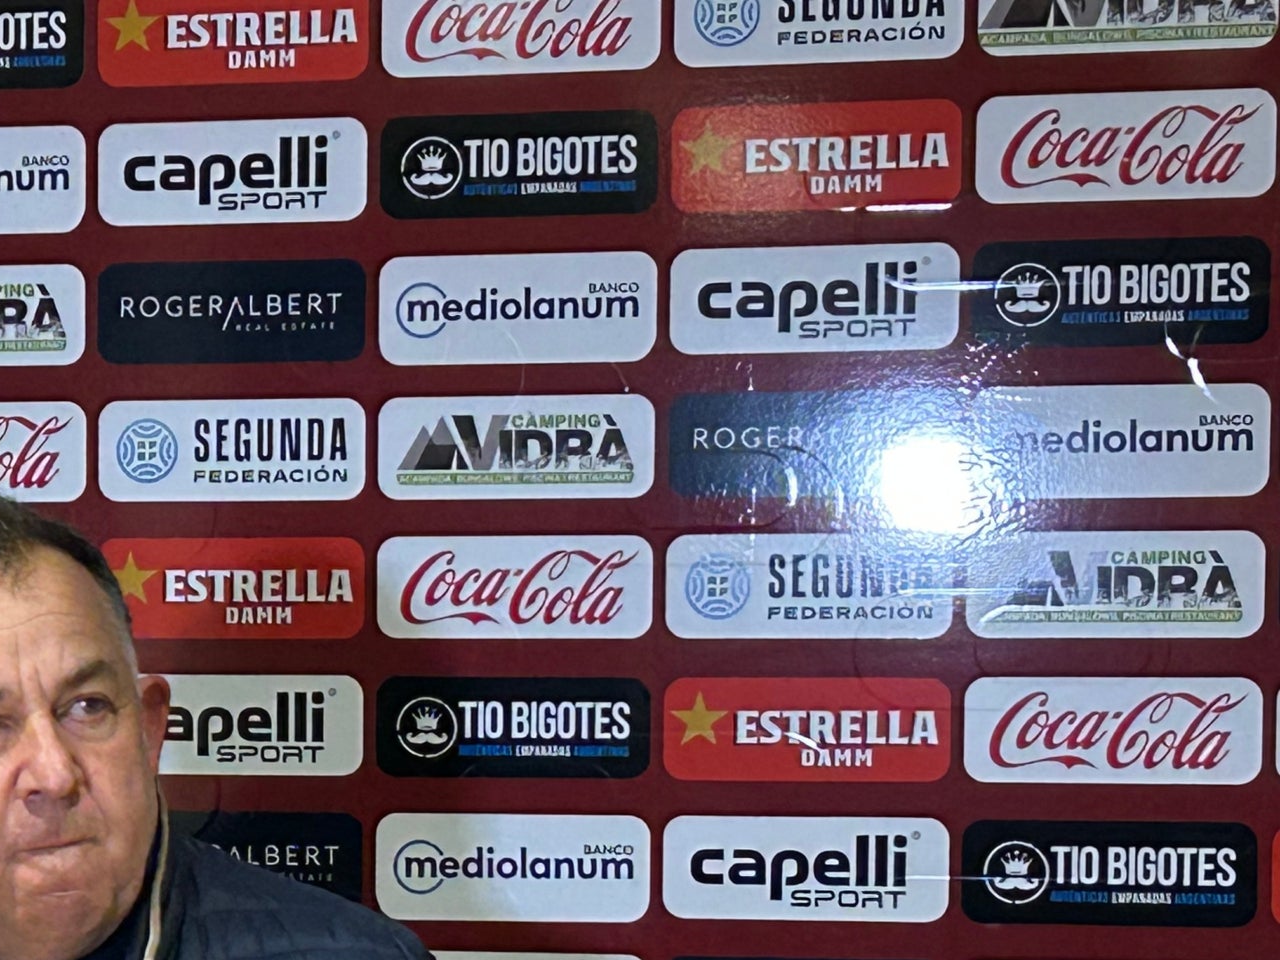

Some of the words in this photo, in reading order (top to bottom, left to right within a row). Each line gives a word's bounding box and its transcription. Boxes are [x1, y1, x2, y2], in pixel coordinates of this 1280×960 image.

[166, 10, 357, 50] ESTRELLA
[777, 23, 945, 45] FEDERACIÓN
[228, 49, 295, 69] DAMM
[22, 155, 69, 166] BANCO
[464, 139, 509, 177] TIO
[517, 135, 637, 176] BIGOTES
[745, 132, 949, 173] ESTRELLA
[124, 135, 328, 205] capelli
[810, 173, 882, 195] DAMM
[218, 191, 327, 211] SPORT
[589, 282, 639, 295] BANCO
[698, 261, 917, 333] capelli
[1062, 265, 1112, 305] TIO
[1120, 262, 1250, 304] BIGOTES
[407, 287, 639, 321] mediolanum
[798, 319, 916, 338] SPORT
[1199, 415, 1253, 426] BANCO
[193, 418, 347, 463] SEGUNDA
[193, 465, 348, 483] FEDERACIÓN
[165, 569, 353, 603] ESTRELLA
[226, 607, 292, 625] DAMM
[164, 692, 325, 756] apelli
[458, 701, 504, 739] TIO
[511, 701, 630, 740] BIGOTES
[734, 710, 938, 746] ESTRELLA
[217, 746, 324, 763] SPORT
[801, 748, 873, 767] DAMM
[404, 846, 634, 881] mediolanum
[584, 844, 634, 855] BANCO
[691, 834, 907, 899] capelli
[1050, 846, 1099, 884] TIO
[1107, 847, 1236, 886] BIGOTES
[790, 889, 906, 909] SPORT
